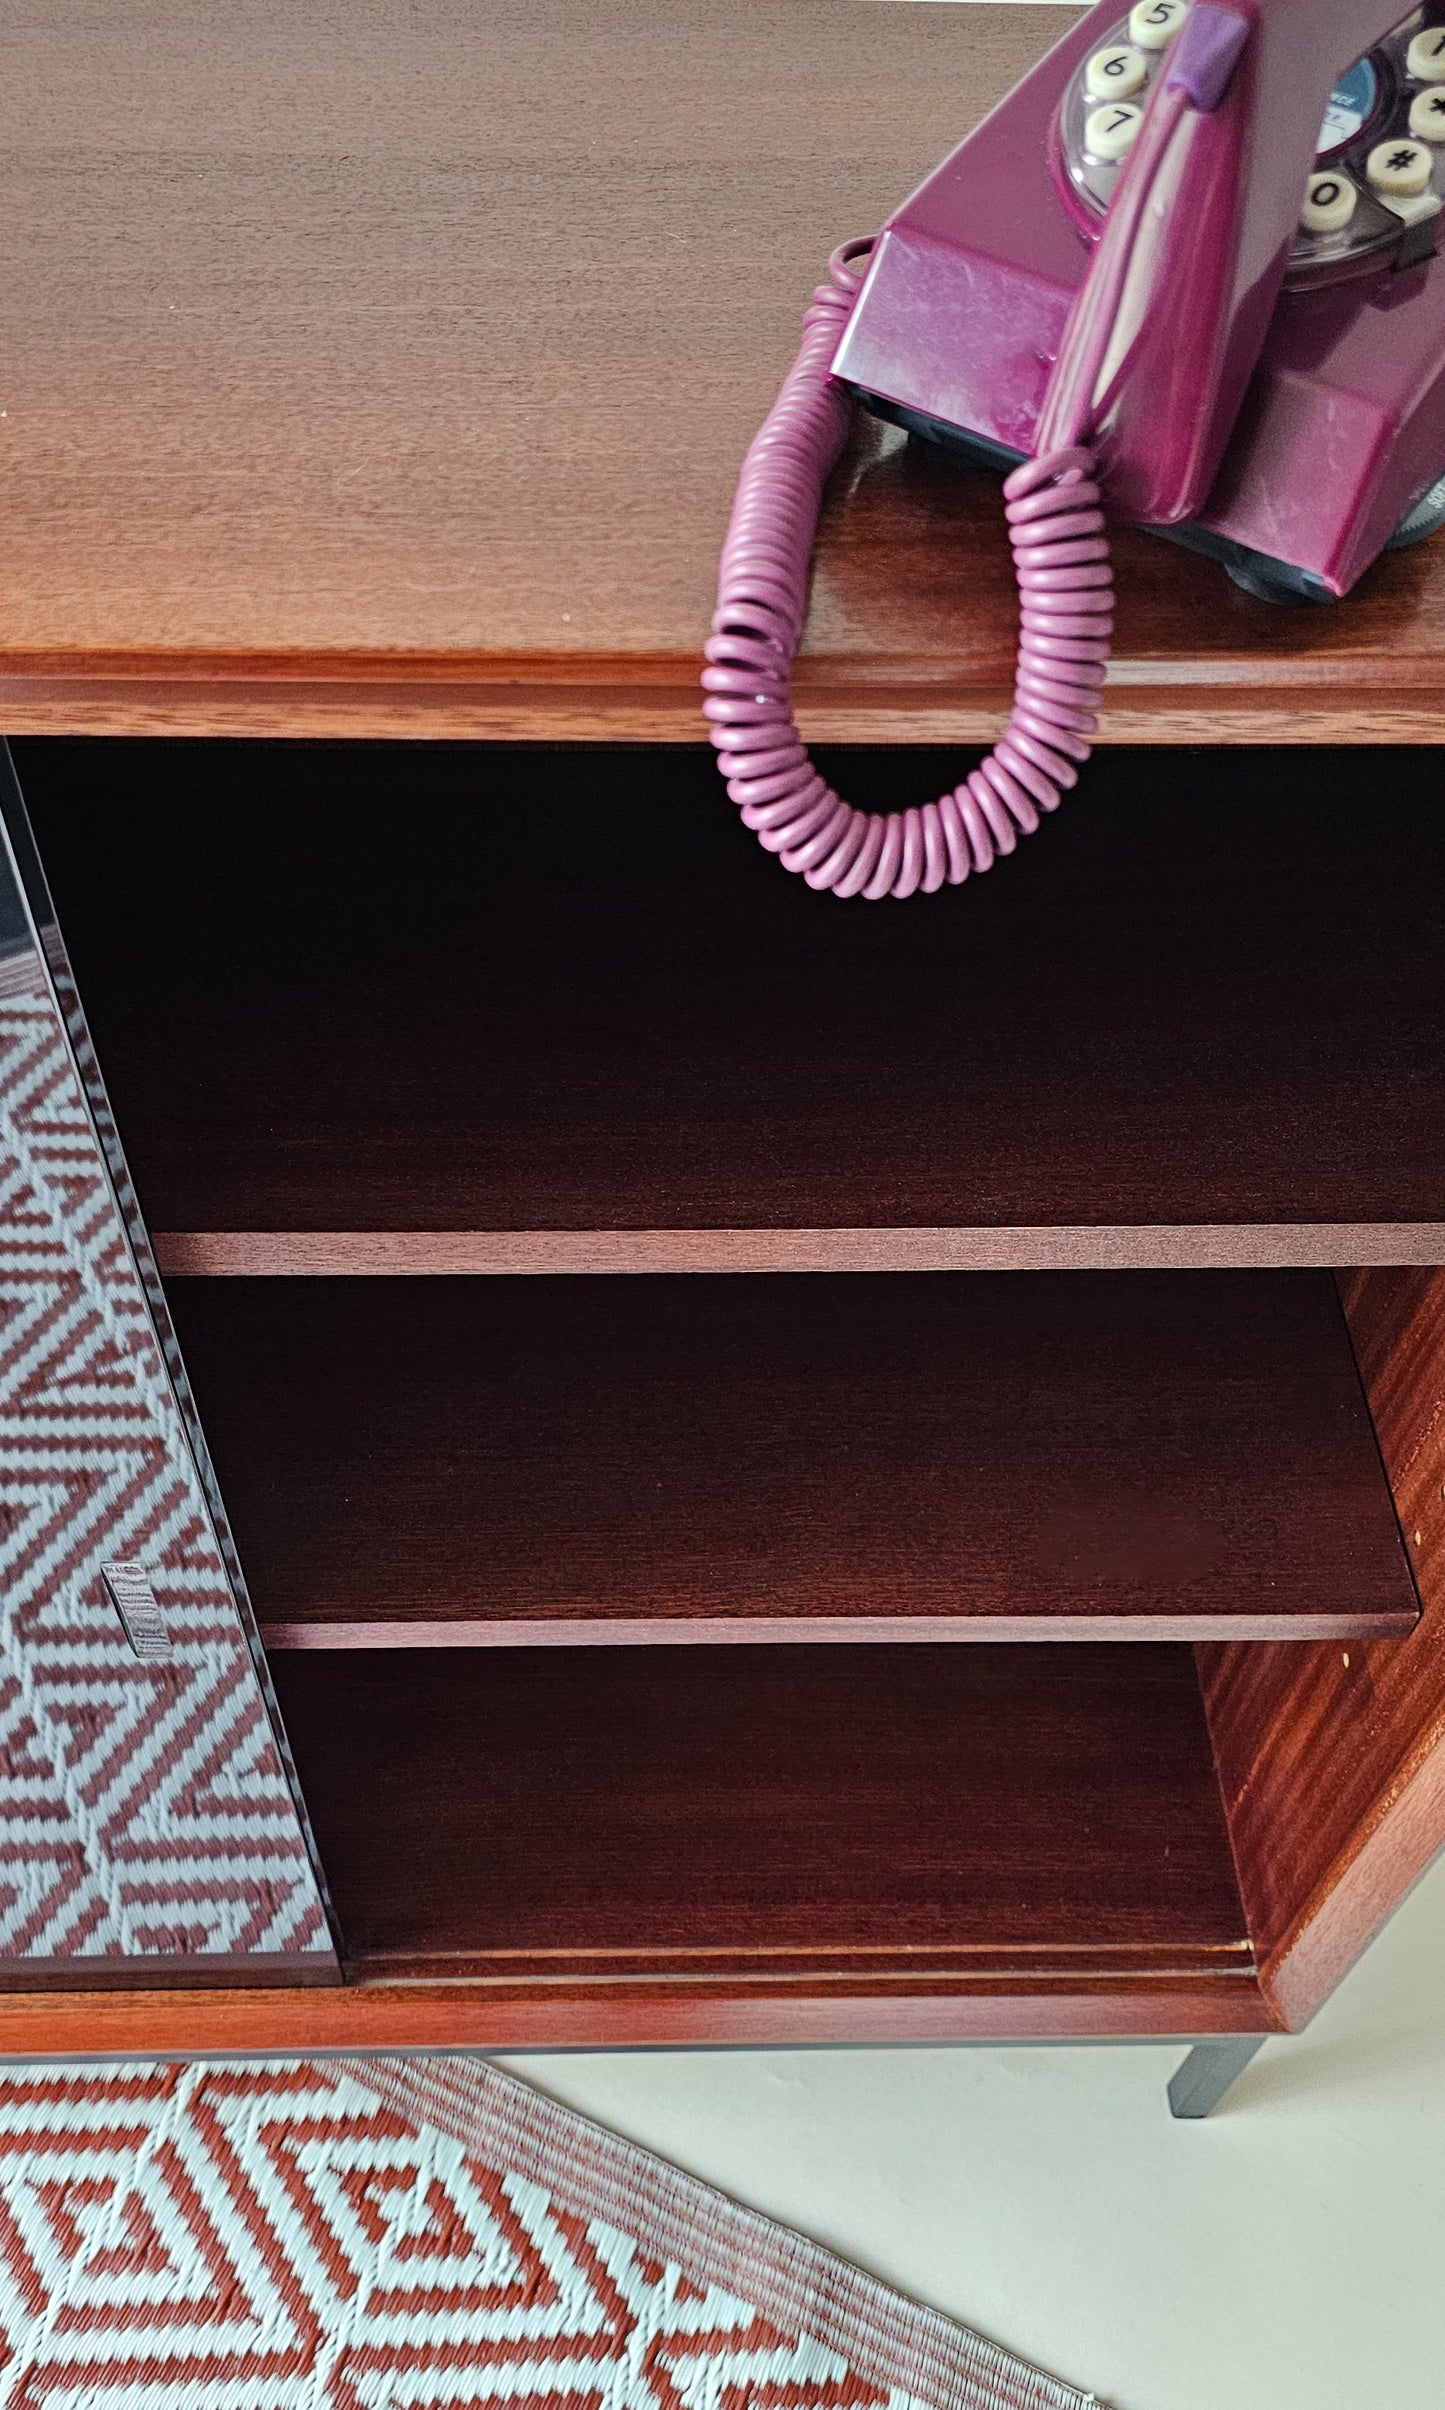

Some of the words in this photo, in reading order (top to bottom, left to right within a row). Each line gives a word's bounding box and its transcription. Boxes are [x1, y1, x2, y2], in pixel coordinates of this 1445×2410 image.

[1144, 3, 1176, 24] 5
[1104, 56, 1128, 76] 6
[1104, 109, 1134, 132] 7
[1385, 150, 1418, 171] #
